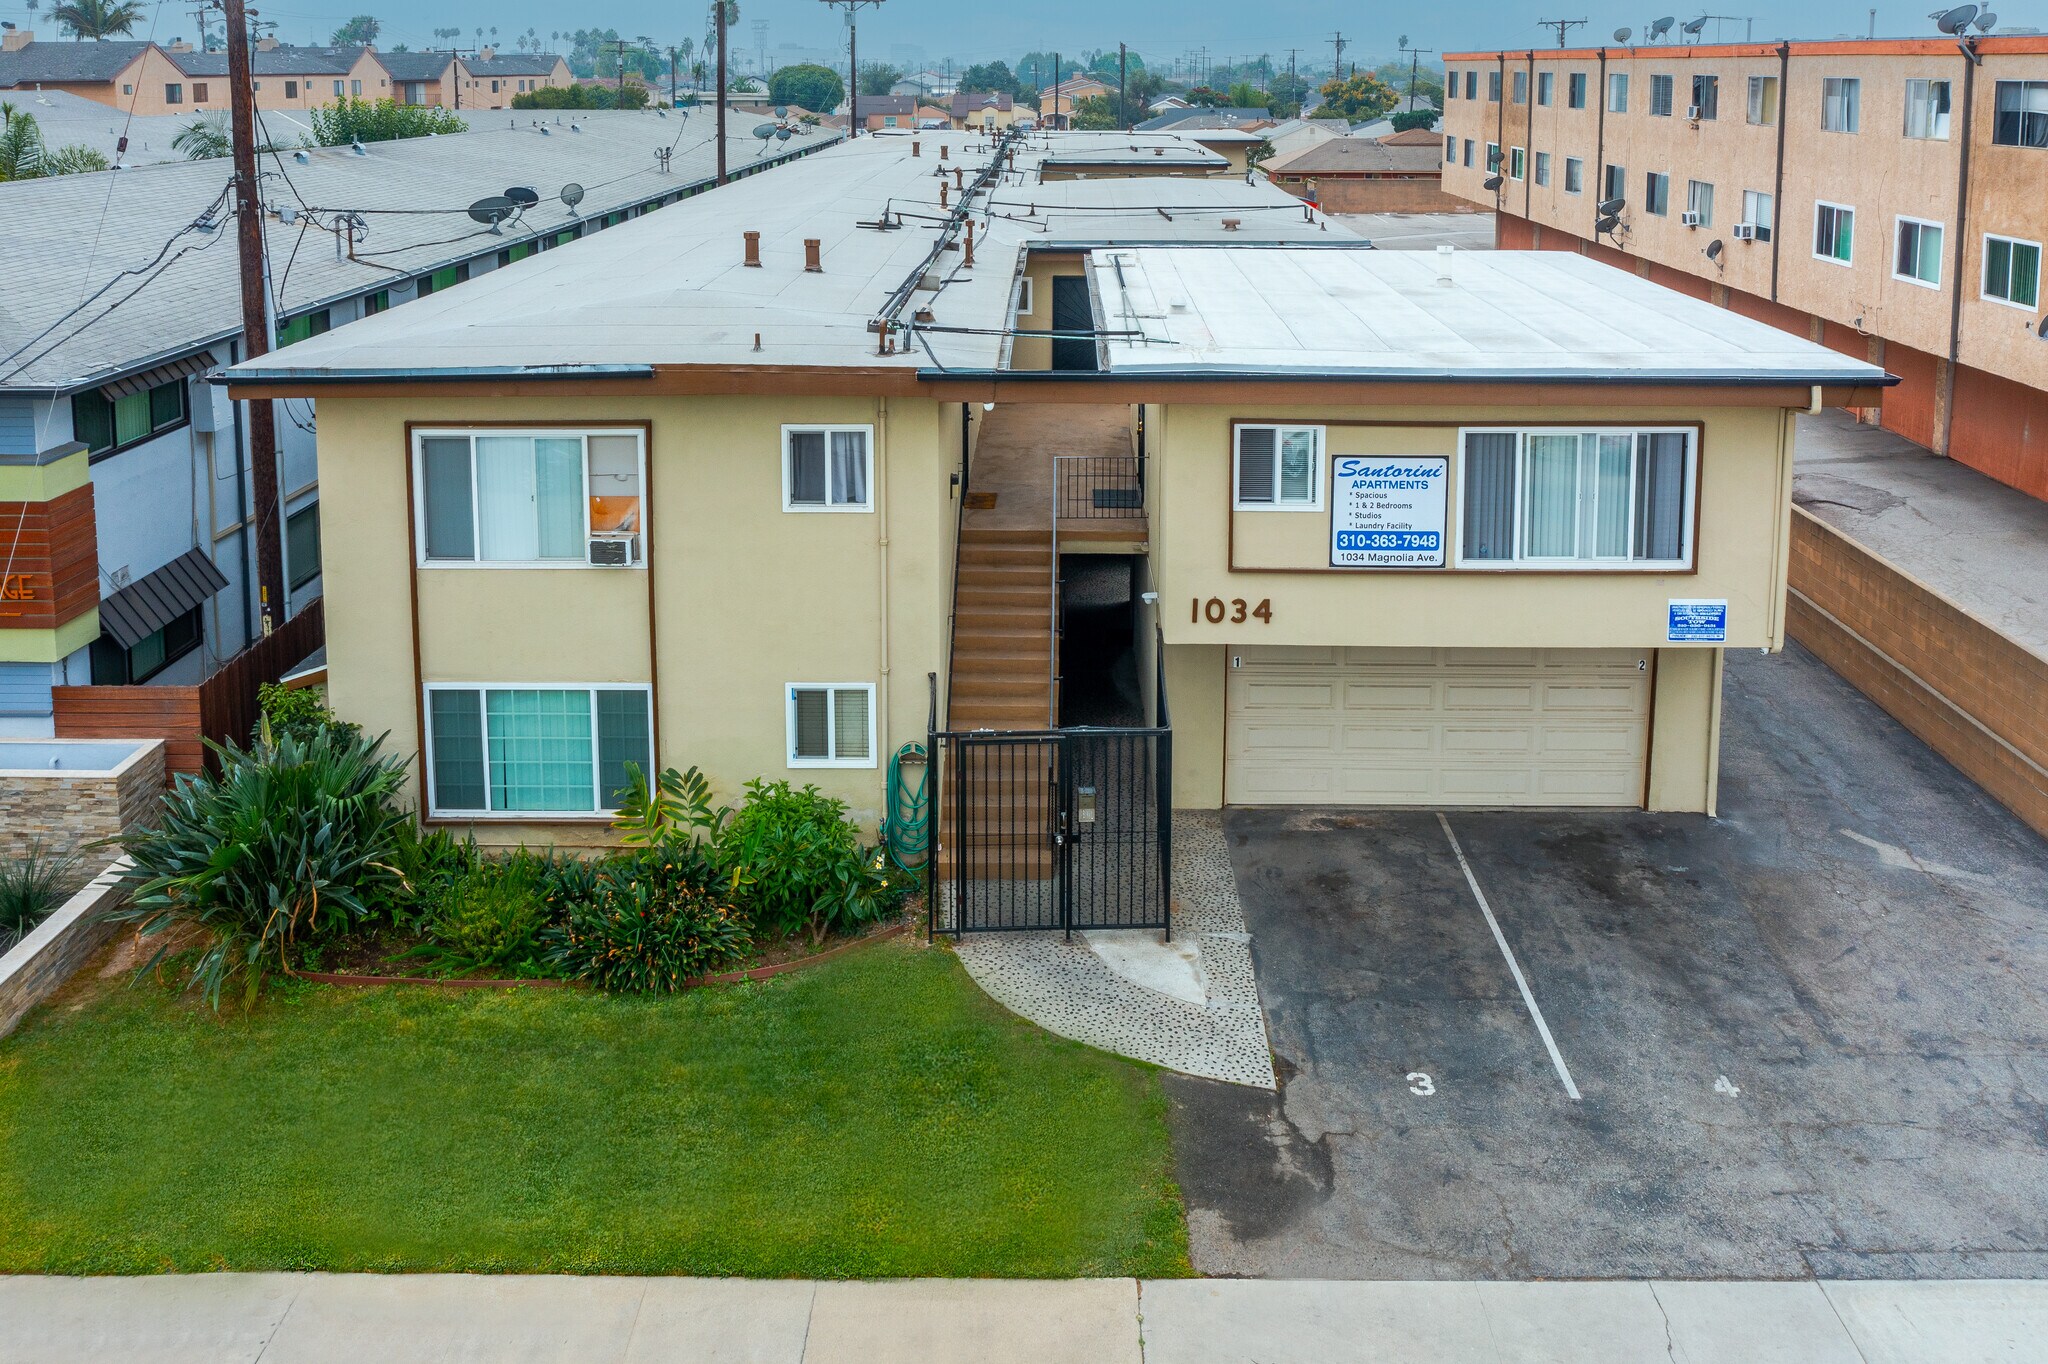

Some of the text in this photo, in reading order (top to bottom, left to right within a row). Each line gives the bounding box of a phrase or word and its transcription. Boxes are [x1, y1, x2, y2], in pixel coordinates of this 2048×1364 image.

[1337, 460, 1443, 478] Santorini
[1351, 480, 1429, 490] APARTMENTS
[1355, 491, 1388, 500] Spacious
[1355, 522, 1413, 530] Laundry Facility
[1339, 534, 1437, 548] 310-363-7948
[1340, 553, 1438, 563] 1034 Magnolia Ave.
[1191, 597, 1273, 624] 1034
[1235, 656, 1240, 668] 1
[1639, 660, 1646, 671] 2
[1406, 1072, 1436, 1096] 3
[1713, 1075, 1741, 1098] 4
